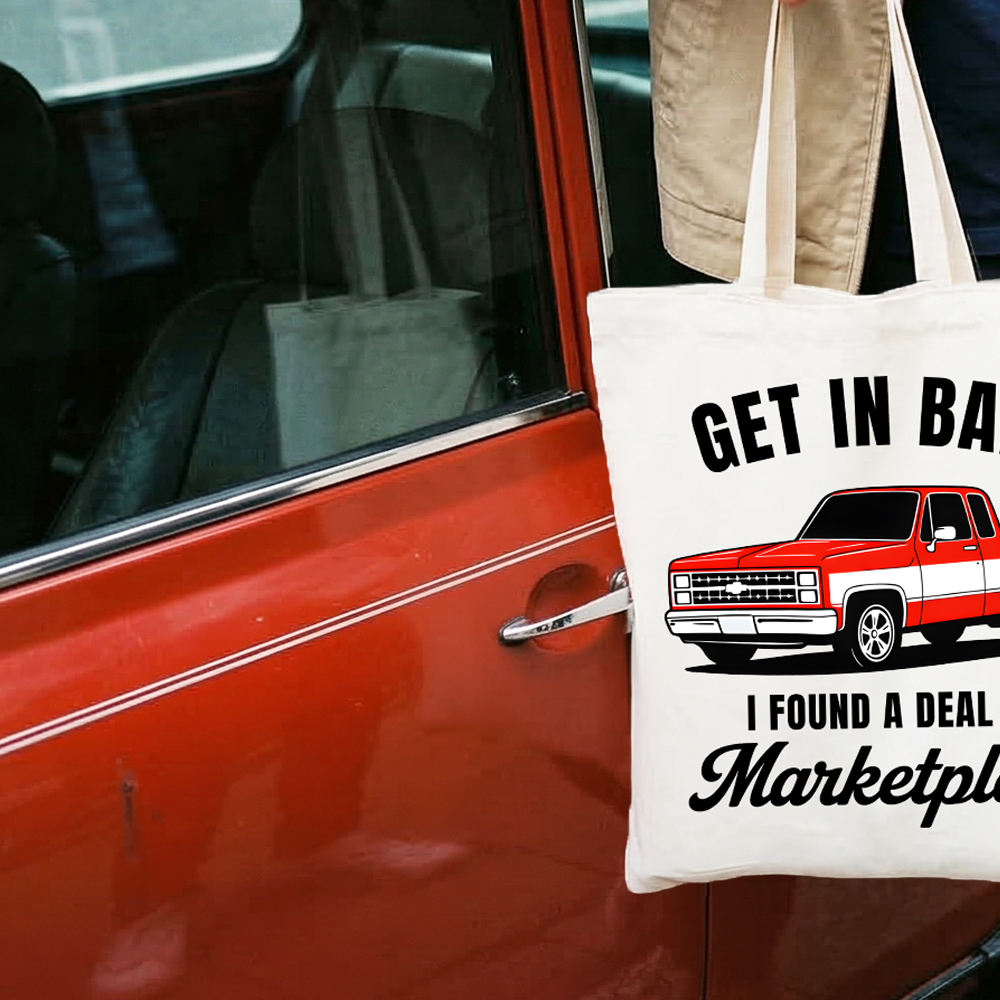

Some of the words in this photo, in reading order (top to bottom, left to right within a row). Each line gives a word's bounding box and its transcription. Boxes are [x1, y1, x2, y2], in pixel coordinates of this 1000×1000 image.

[691, 377, 800, 473] GET
[829, 375, 891, 449] IN
[747, 694, 756, 731] I
[769, 693, 870, 731] FOUND
[883, 692, 903, 729] A
[916, 690, 994, 728] DEAL
